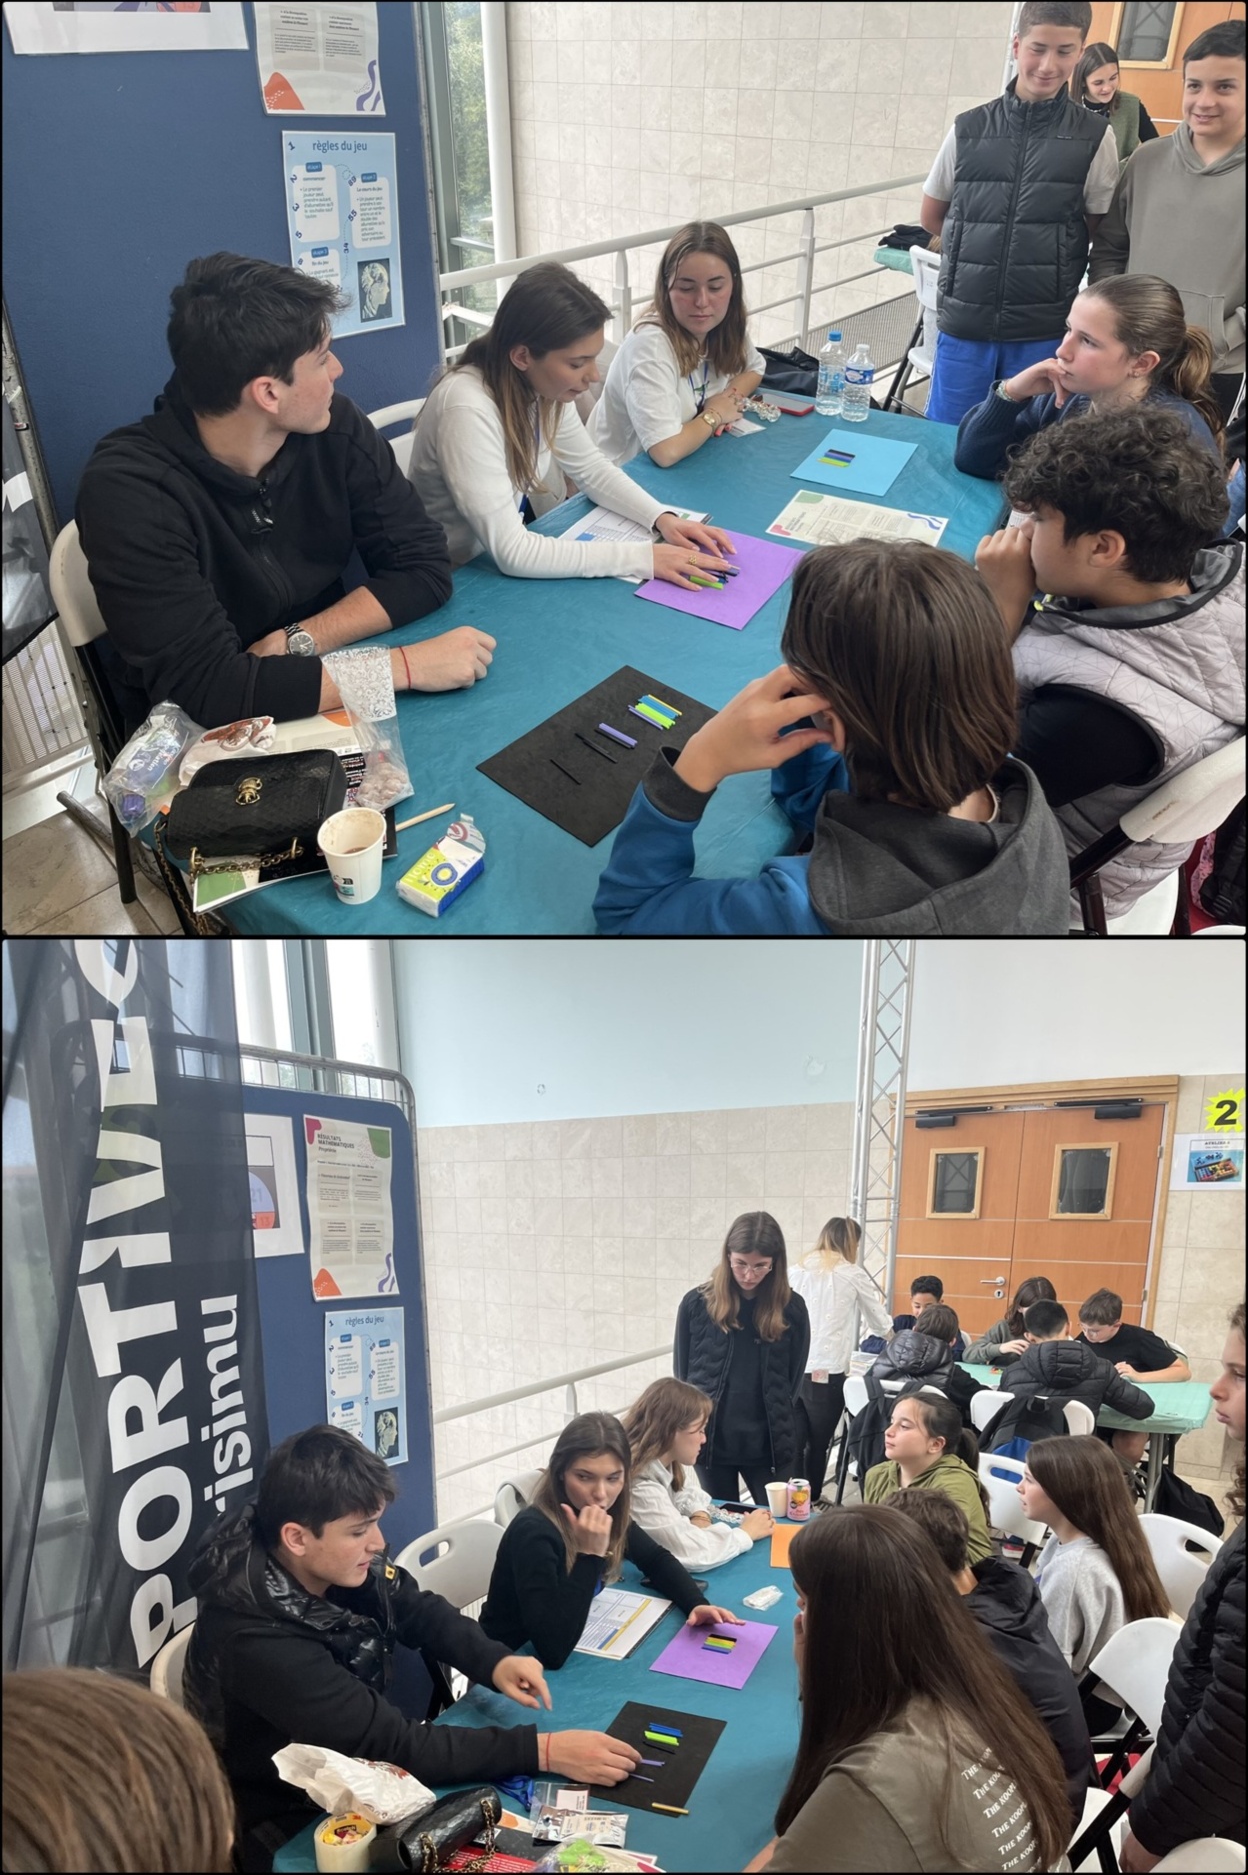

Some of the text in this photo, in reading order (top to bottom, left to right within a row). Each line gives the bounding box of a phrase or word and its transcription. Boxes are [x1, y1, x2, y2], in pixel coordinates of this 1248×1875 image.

[312, 140, 368, 154] règles du jeu
[348, 209, 357, 222] 55
[1214, 1100, 1238, 1126] 2
[345, 1314, 384, 1327] règles du jeu
[200, 1294, 254, 1516] isimu
[961, 1763, 979, 1780] THE
[973, 1783, 990, 1800] THE
[983, 1802, 1000, 1819] THE
[992, 1822, 1010, 1838] THE
[998, 1840, 1016, 1855] THE
[1002, 1856, 1019, 1871] THE
